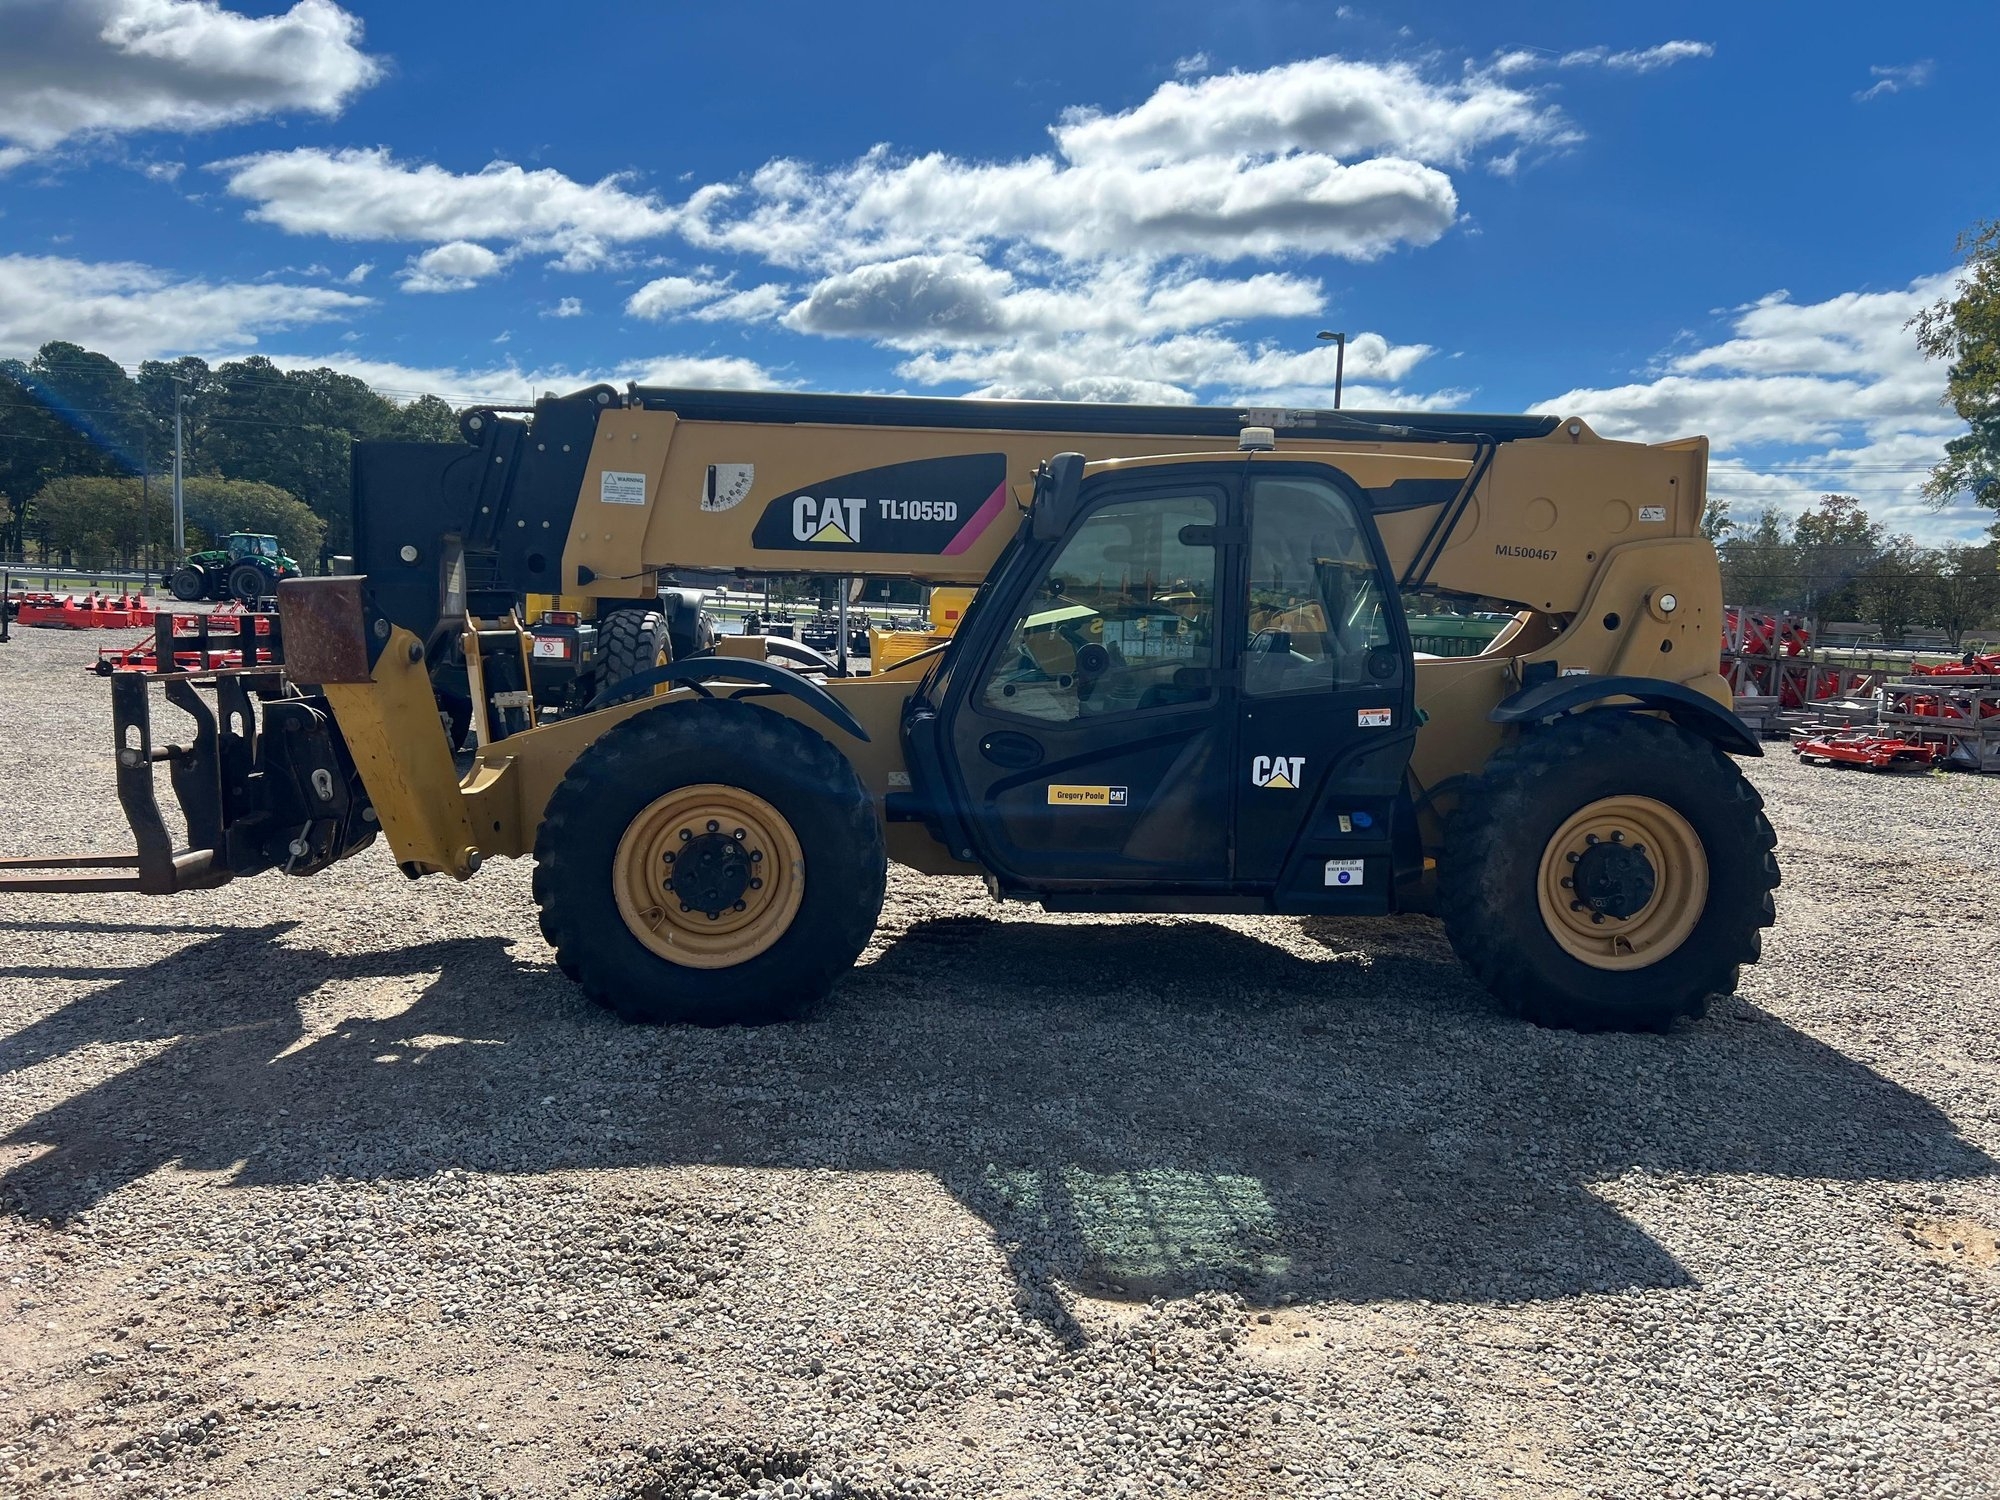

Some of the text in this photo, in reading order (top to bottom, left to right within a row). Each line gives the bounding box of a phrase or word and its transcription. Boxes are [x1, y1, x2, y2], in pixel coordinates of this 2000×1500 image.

[792, 495, 958, 543] CAT TL1055D
[1495, 544, 1558, 561] ML500467
[1252, 755, 1306, 789] CAT
[1057, 791, 1125, 800] Gregory Poole CAT
